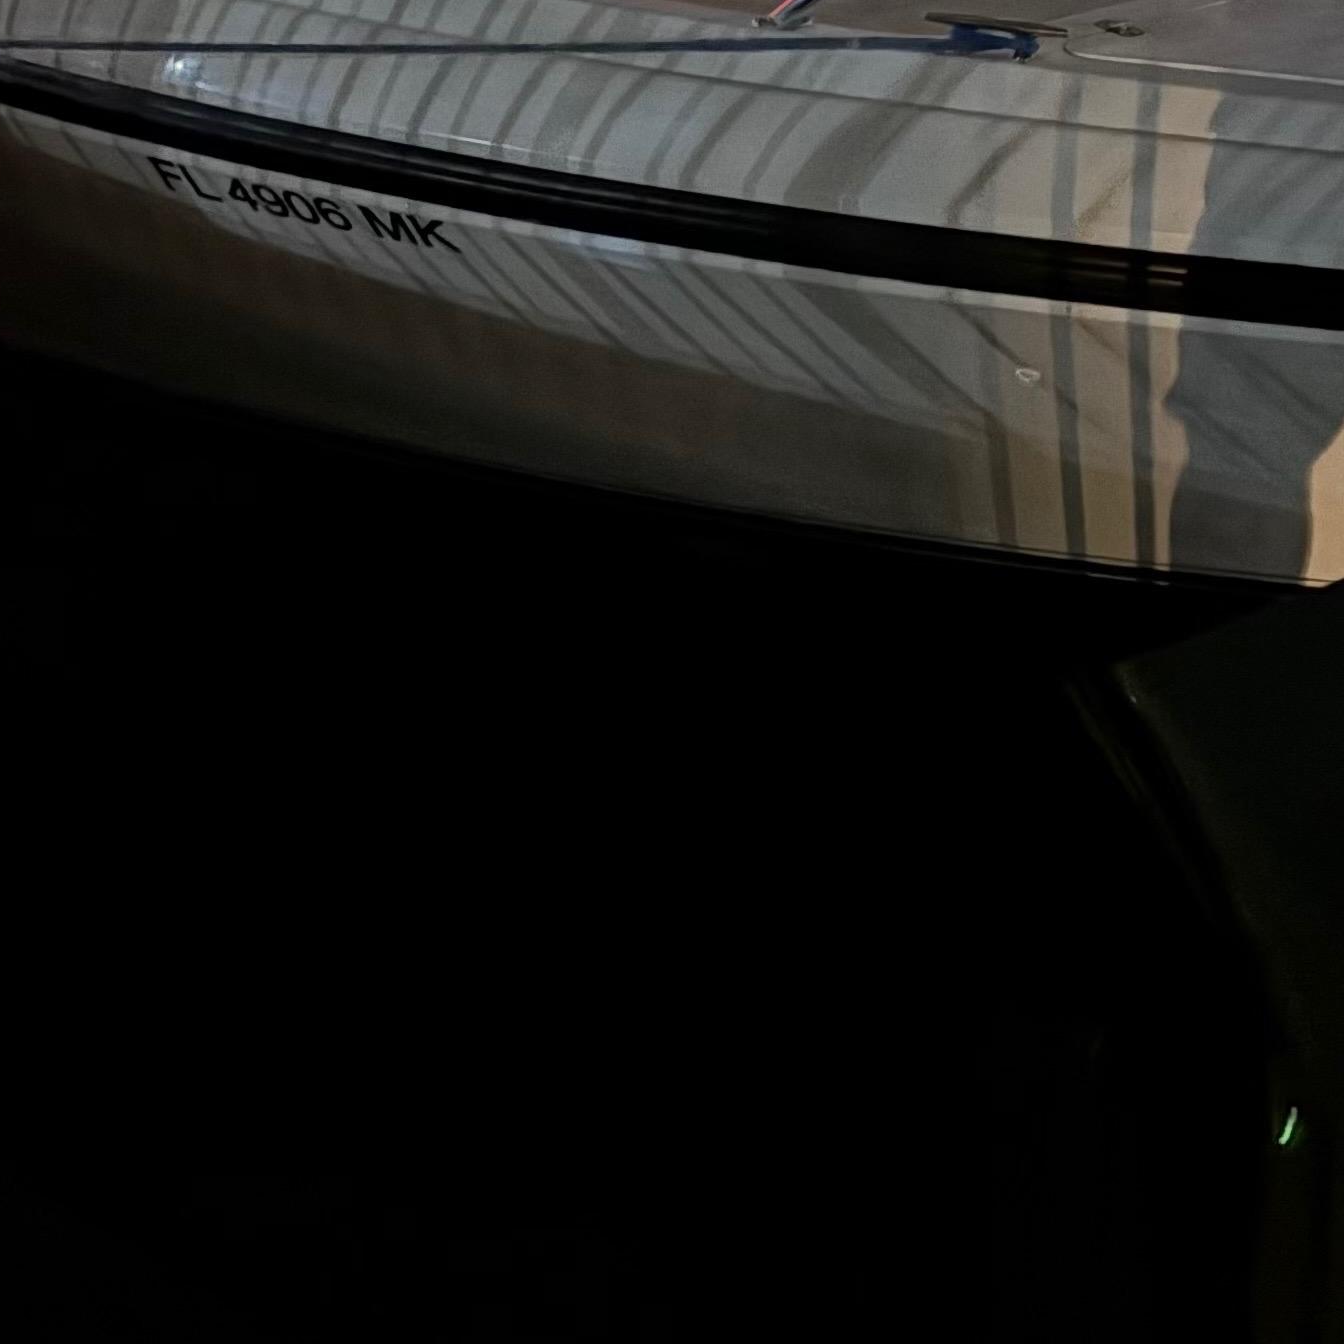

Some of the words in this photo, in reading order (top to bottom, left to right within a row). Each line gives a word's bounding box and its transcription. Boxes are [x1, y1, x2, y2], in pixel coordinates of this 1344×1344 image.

[147, 156, 223, 203] FL
[228, 177, 353, 232] 4906
[357, 204, 462, 254] MK
